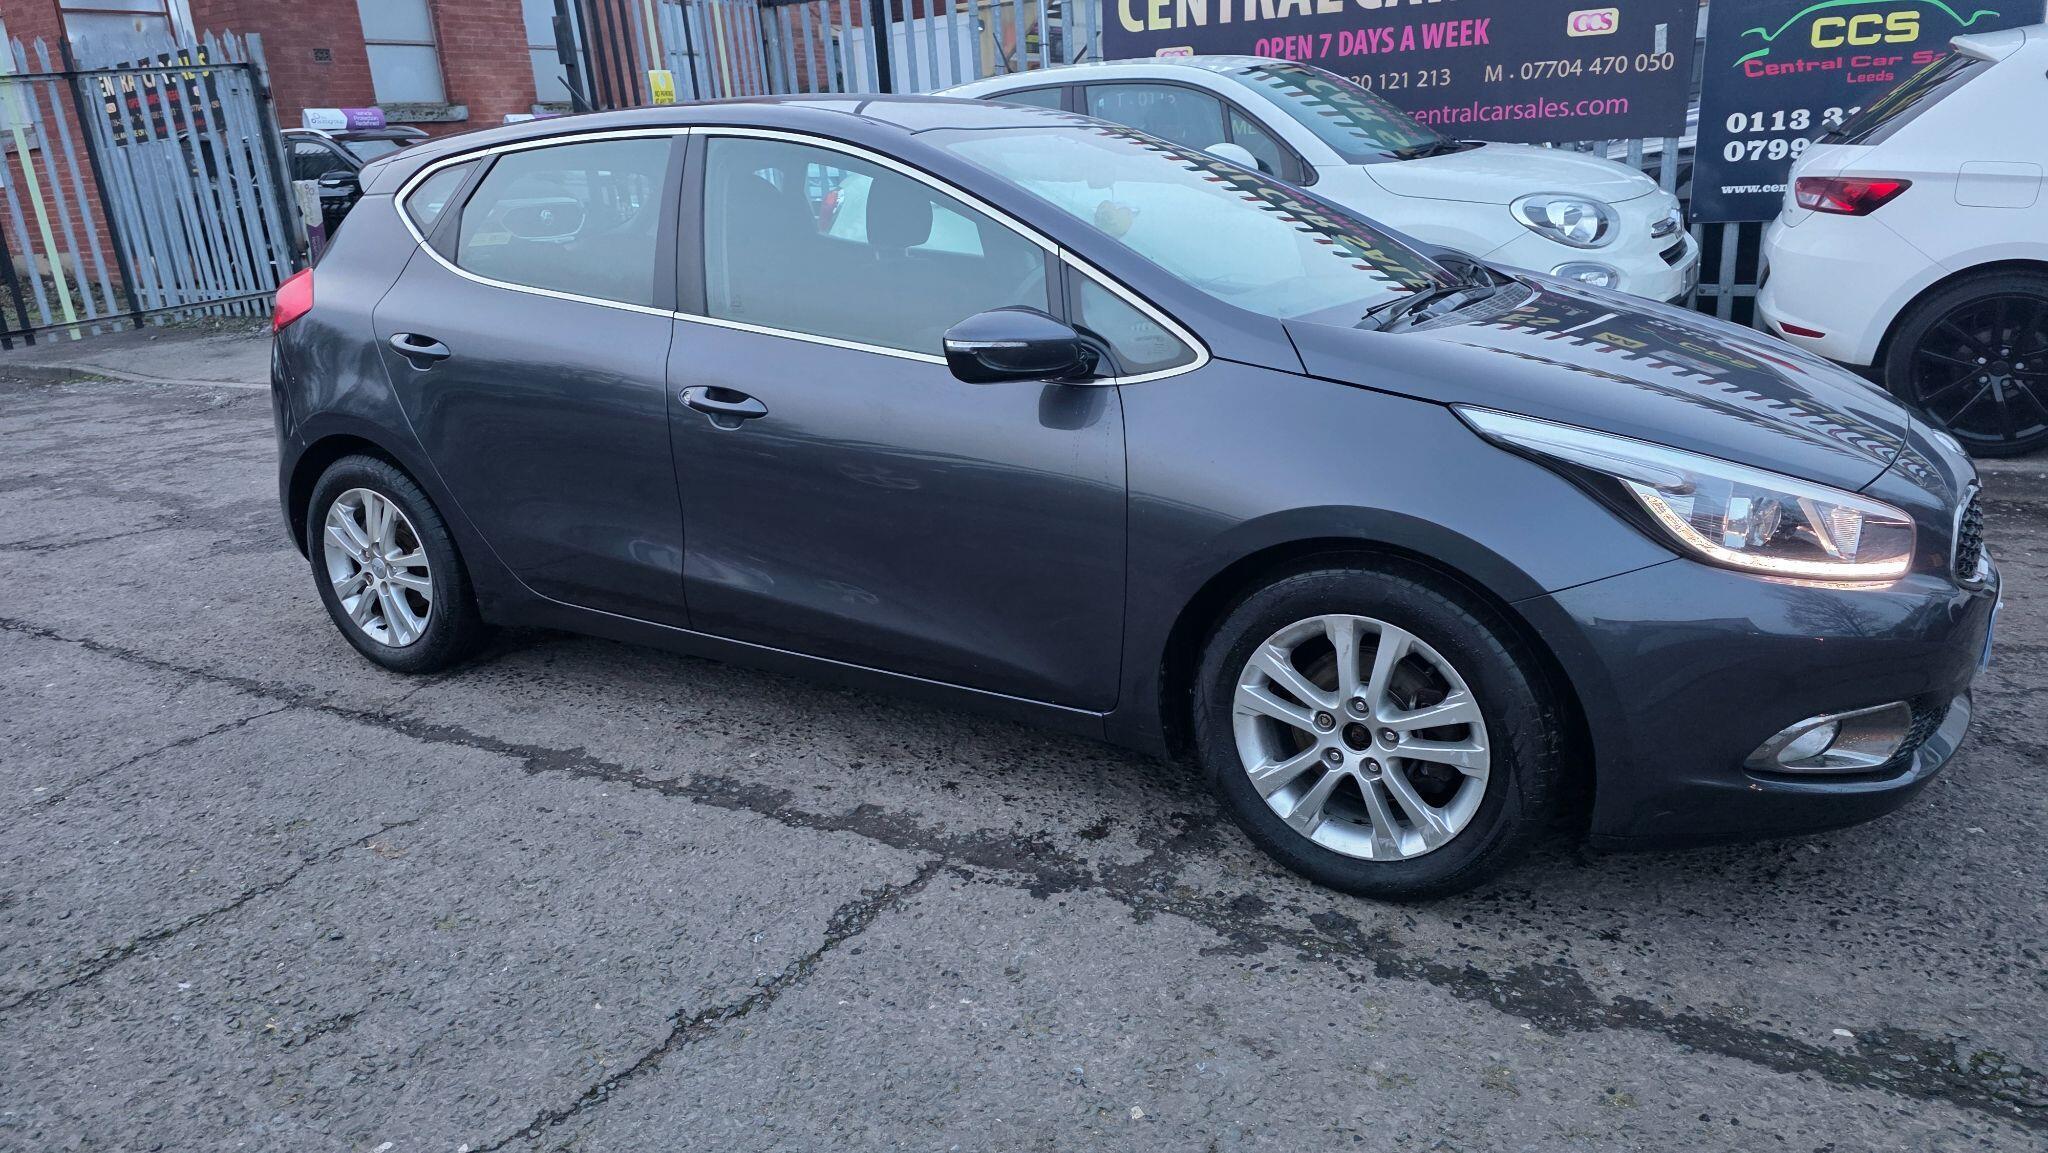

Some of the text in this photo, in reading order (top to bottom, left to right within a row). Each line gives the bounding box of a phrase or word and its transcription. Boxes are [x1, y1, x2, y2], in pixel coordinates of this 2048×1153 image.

[1254, 17, 1491, 60] OPEN 7 DAYS A WEEK
[1811, 11, 1920, 48] CCS
[1379, 72, 1409, 90] 121
[1416, 68, 1451, 88] 213
[1520, 59, 1582, 81] 07704
[1588, 55, 1629, 75] 470
[1634, 52, 1675, 73] 050
[1744, 57, 1842, 78] Central
[1851, 55, 1903, 68] Car
[1847, 71, 1894, 83] Leeds
[1726, 108, 1810, 133] 0113
[1723, 137, 1811, 162] 0799
